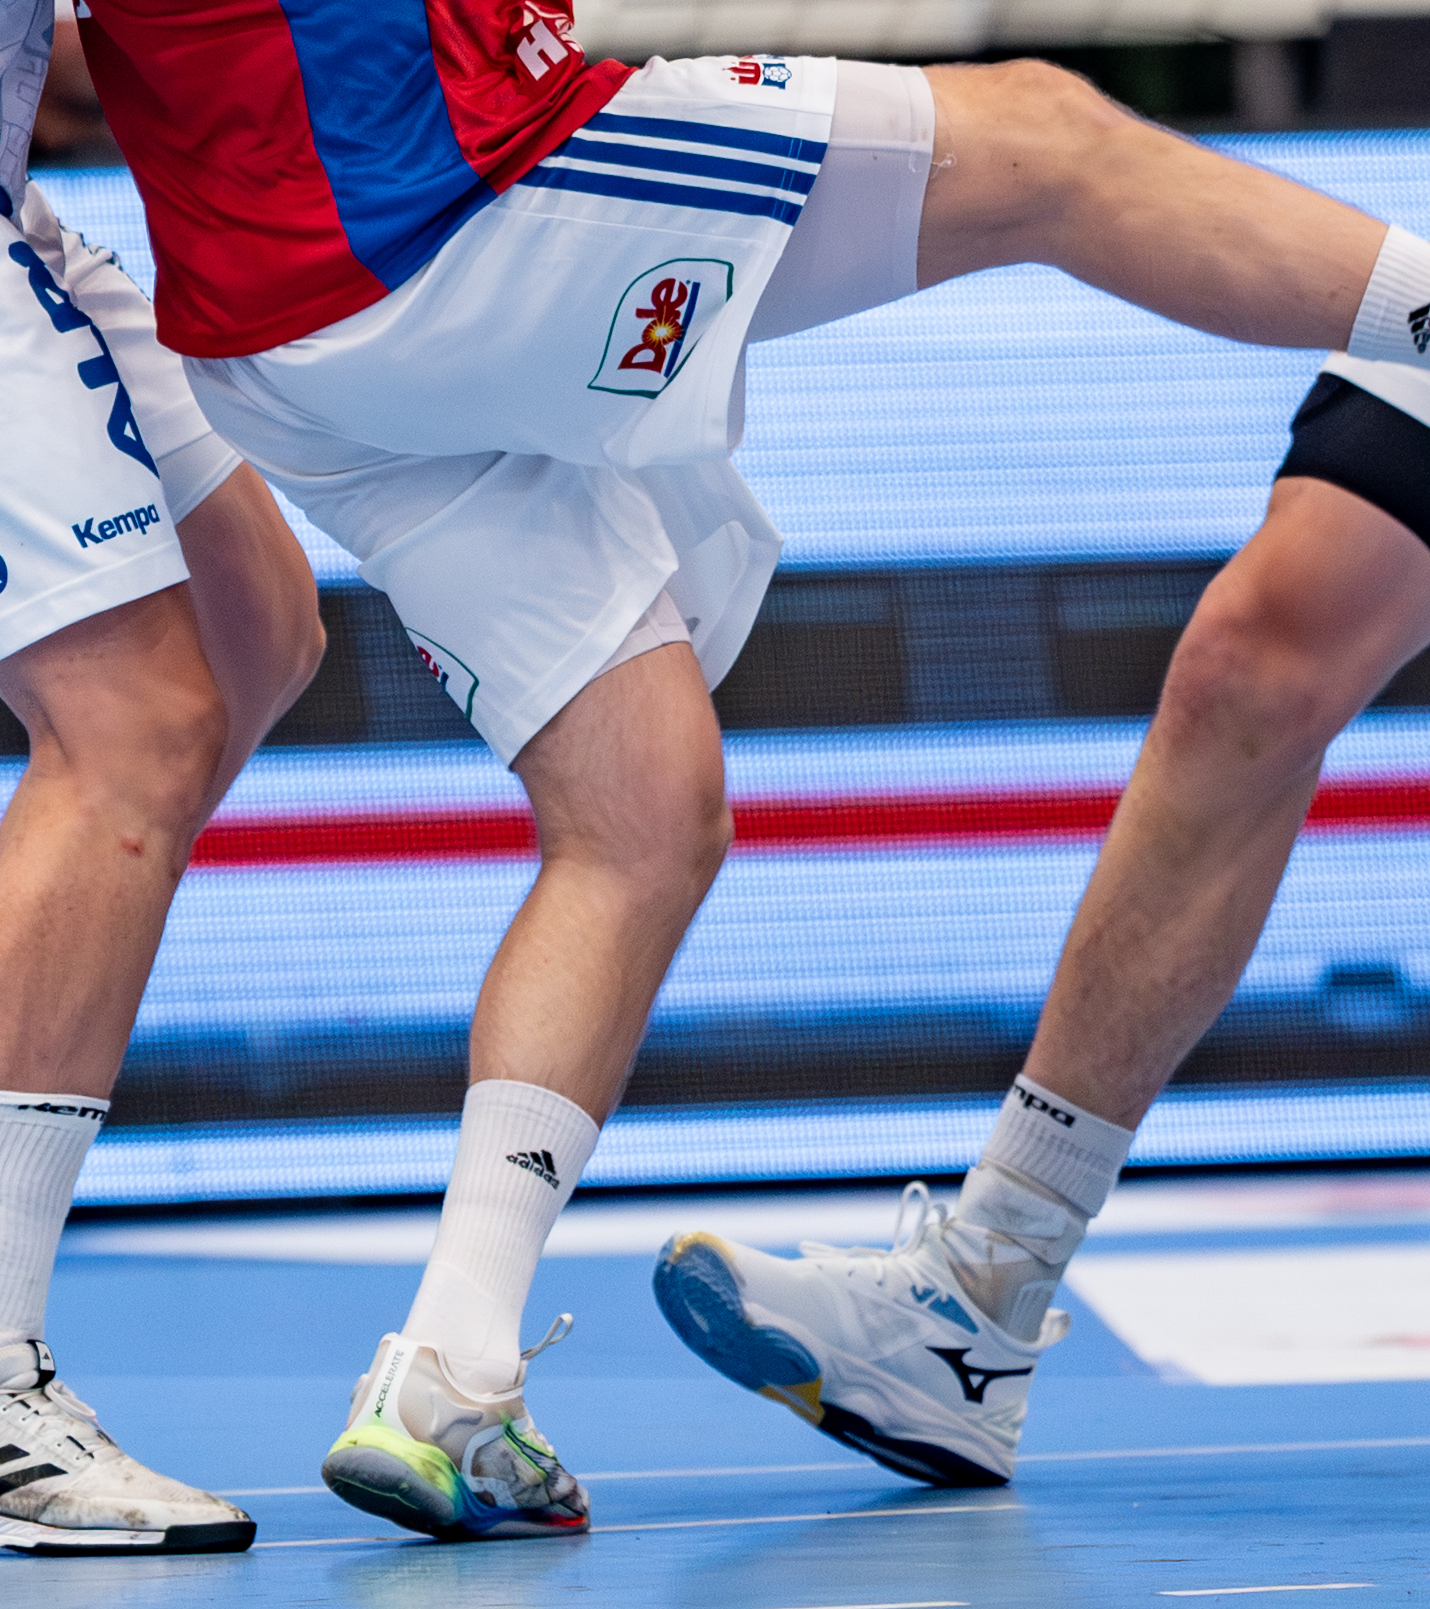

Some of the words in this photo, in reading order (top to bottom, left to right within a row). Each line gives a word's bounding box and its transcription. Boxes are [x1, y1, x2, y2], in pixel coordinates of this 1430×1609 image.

[617, 277, 688, 375] Dole
[71, 503, 161, 549] Kempa
[505, 1153, 561, 1190] adidas
[375, 1348, 405, 1419] ACCELERATE
